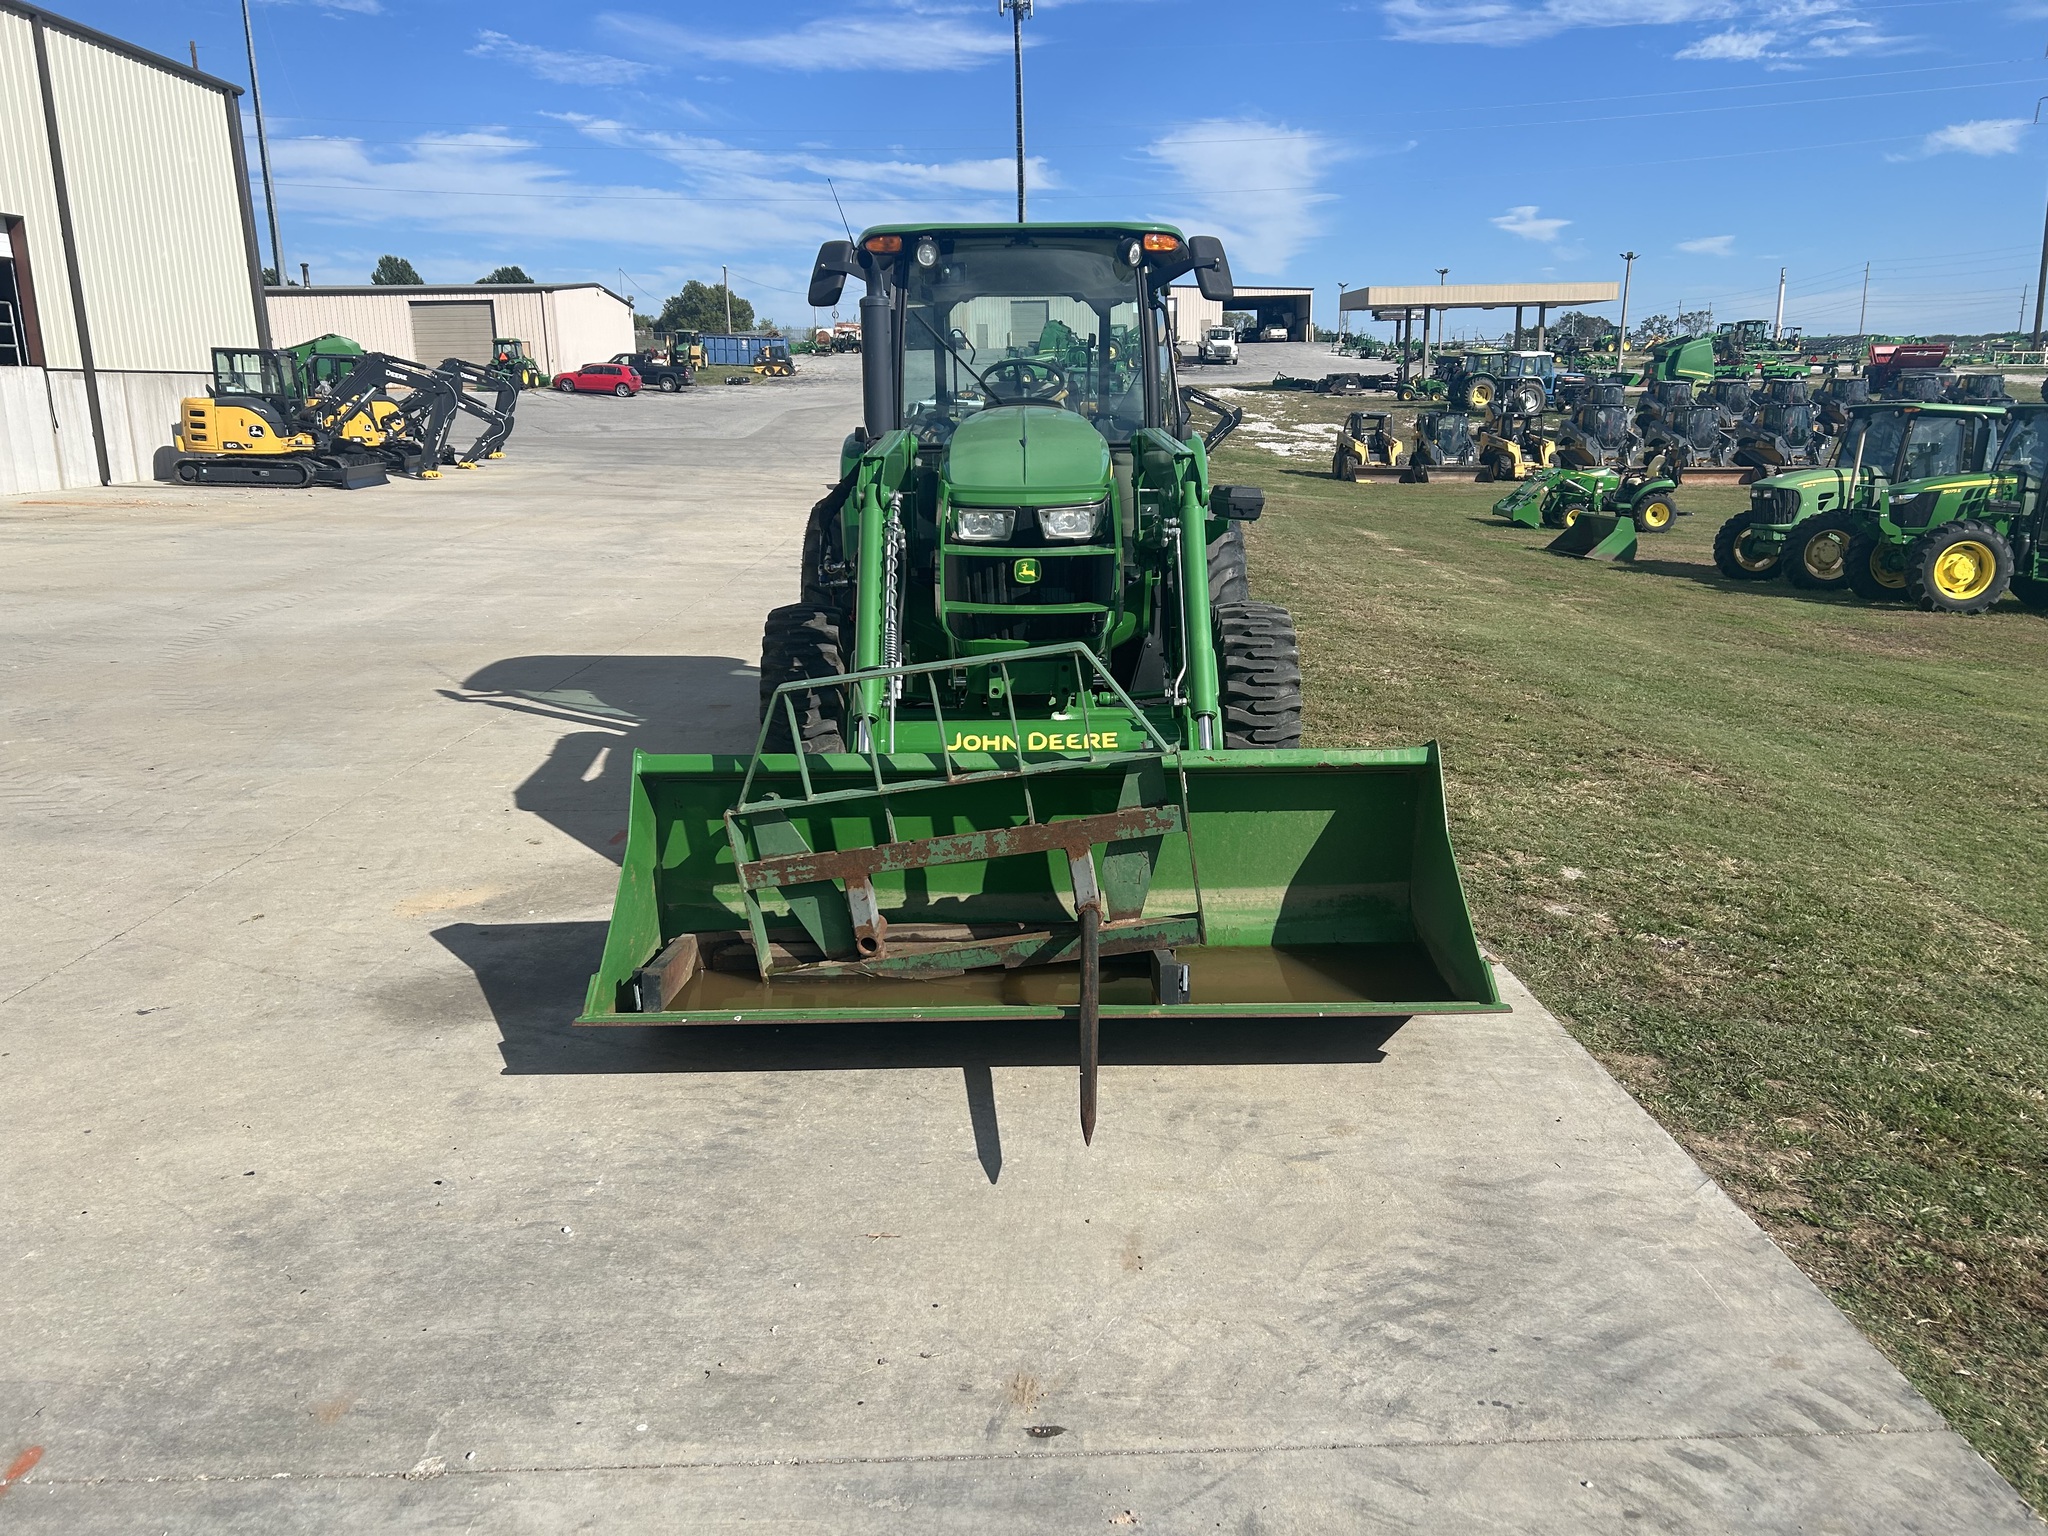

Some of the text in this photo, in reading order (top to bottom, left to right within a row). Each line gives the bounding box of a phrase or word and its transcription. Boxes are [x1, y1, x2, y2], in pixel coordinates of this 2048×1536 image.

[385, 369, 408, 381] DEERE
[947, 731, 1119, 751] JOHN DEERE
